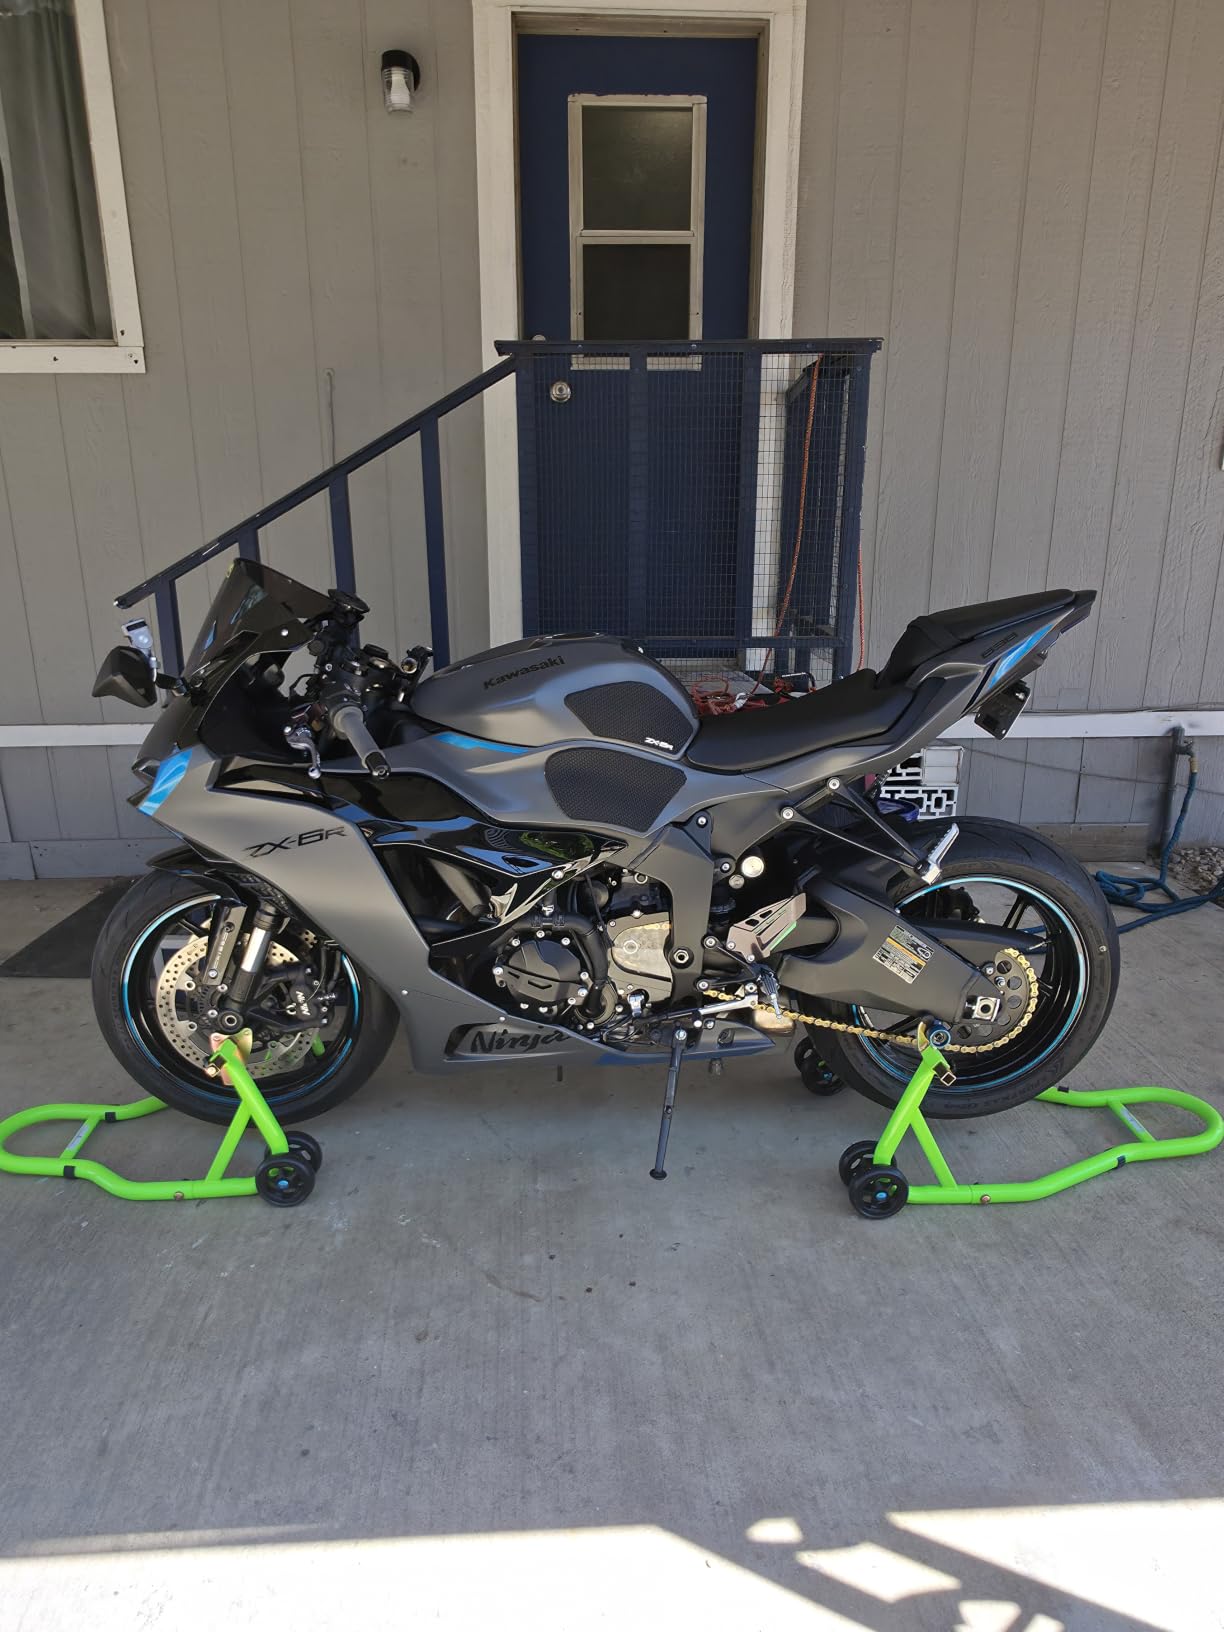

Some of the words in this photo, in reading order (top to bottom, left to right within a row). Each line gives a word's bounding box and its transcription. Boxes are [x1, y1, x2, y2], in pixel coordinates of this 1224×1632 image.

[483, 656, 566, 690] Kawasaki
[243, 827, 348, 858] ZX-6R
[470, 1028, 570, 1053] Ninja
